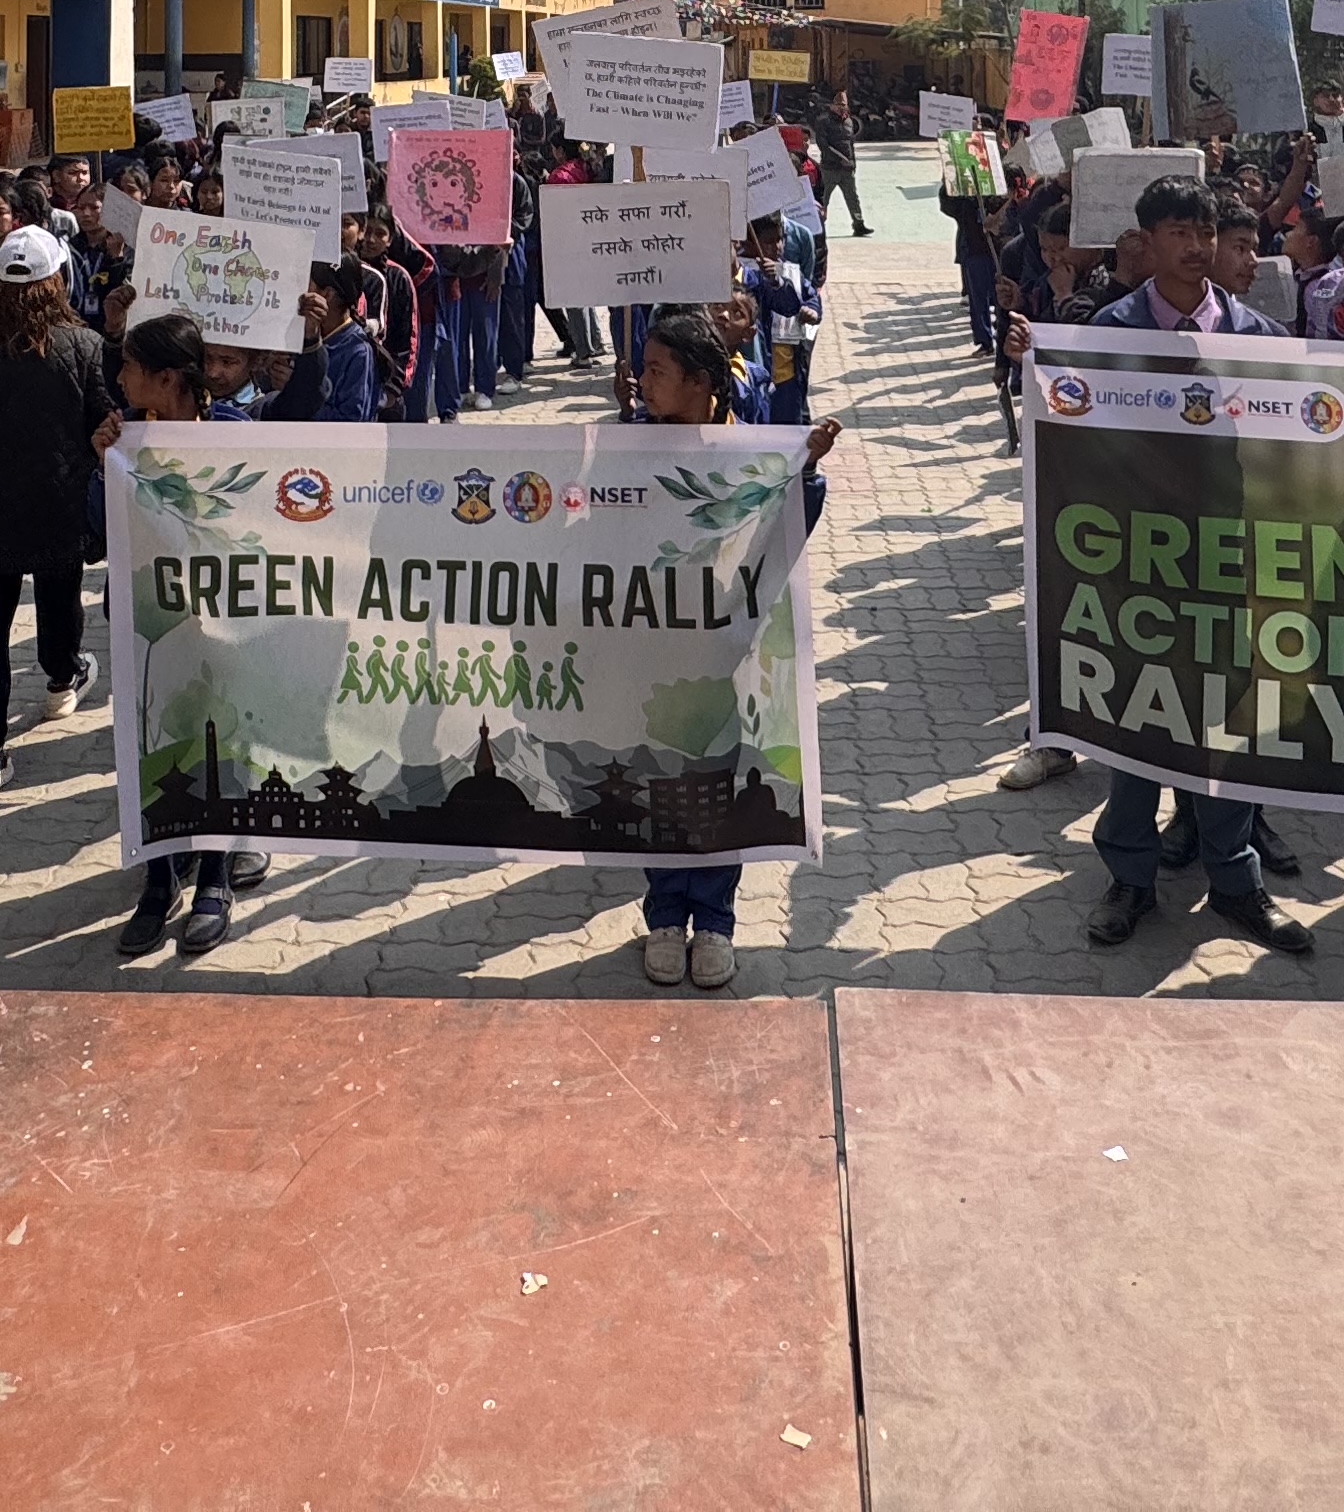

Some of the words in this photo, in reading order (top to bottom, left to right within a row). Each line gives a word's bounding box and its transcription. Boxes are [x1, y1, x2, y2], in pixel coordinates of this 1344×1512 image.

[585, 88, 603, 98] The
[606, 90, 644, 103] Climate
[656, 94, 705, 109] Changing
[621, 106, 649, 118] When
[247, 196, 265, 206] Earth
[303, 218, 322, 228] Our
[580, 206, 609, 225] सके
[618, 206, 651, 222] सफा
[150, 222, 186, 247] One
[197, 225, 252, 254] Earth
[592, 237, 632, 256] नसके
[641, 233, 685, 253] फोहोर
[192, 257, 219, 276] One
[615, 267, 663, 286] नगरौं।
[197, 284, 254, 307] Protect
[265, 291, 280, 309] it
[1095, 389, 1154, 407] unicef
[1248, 400, 1294, 415] NSET
[342, 479, 414, 504] unicef
[590, 486, 648, 503] NSET
[154, 554, 334, 618] GREEN
[357, 557, 559, 626] ACTION
[583, 553, 769, 630] RALLY
